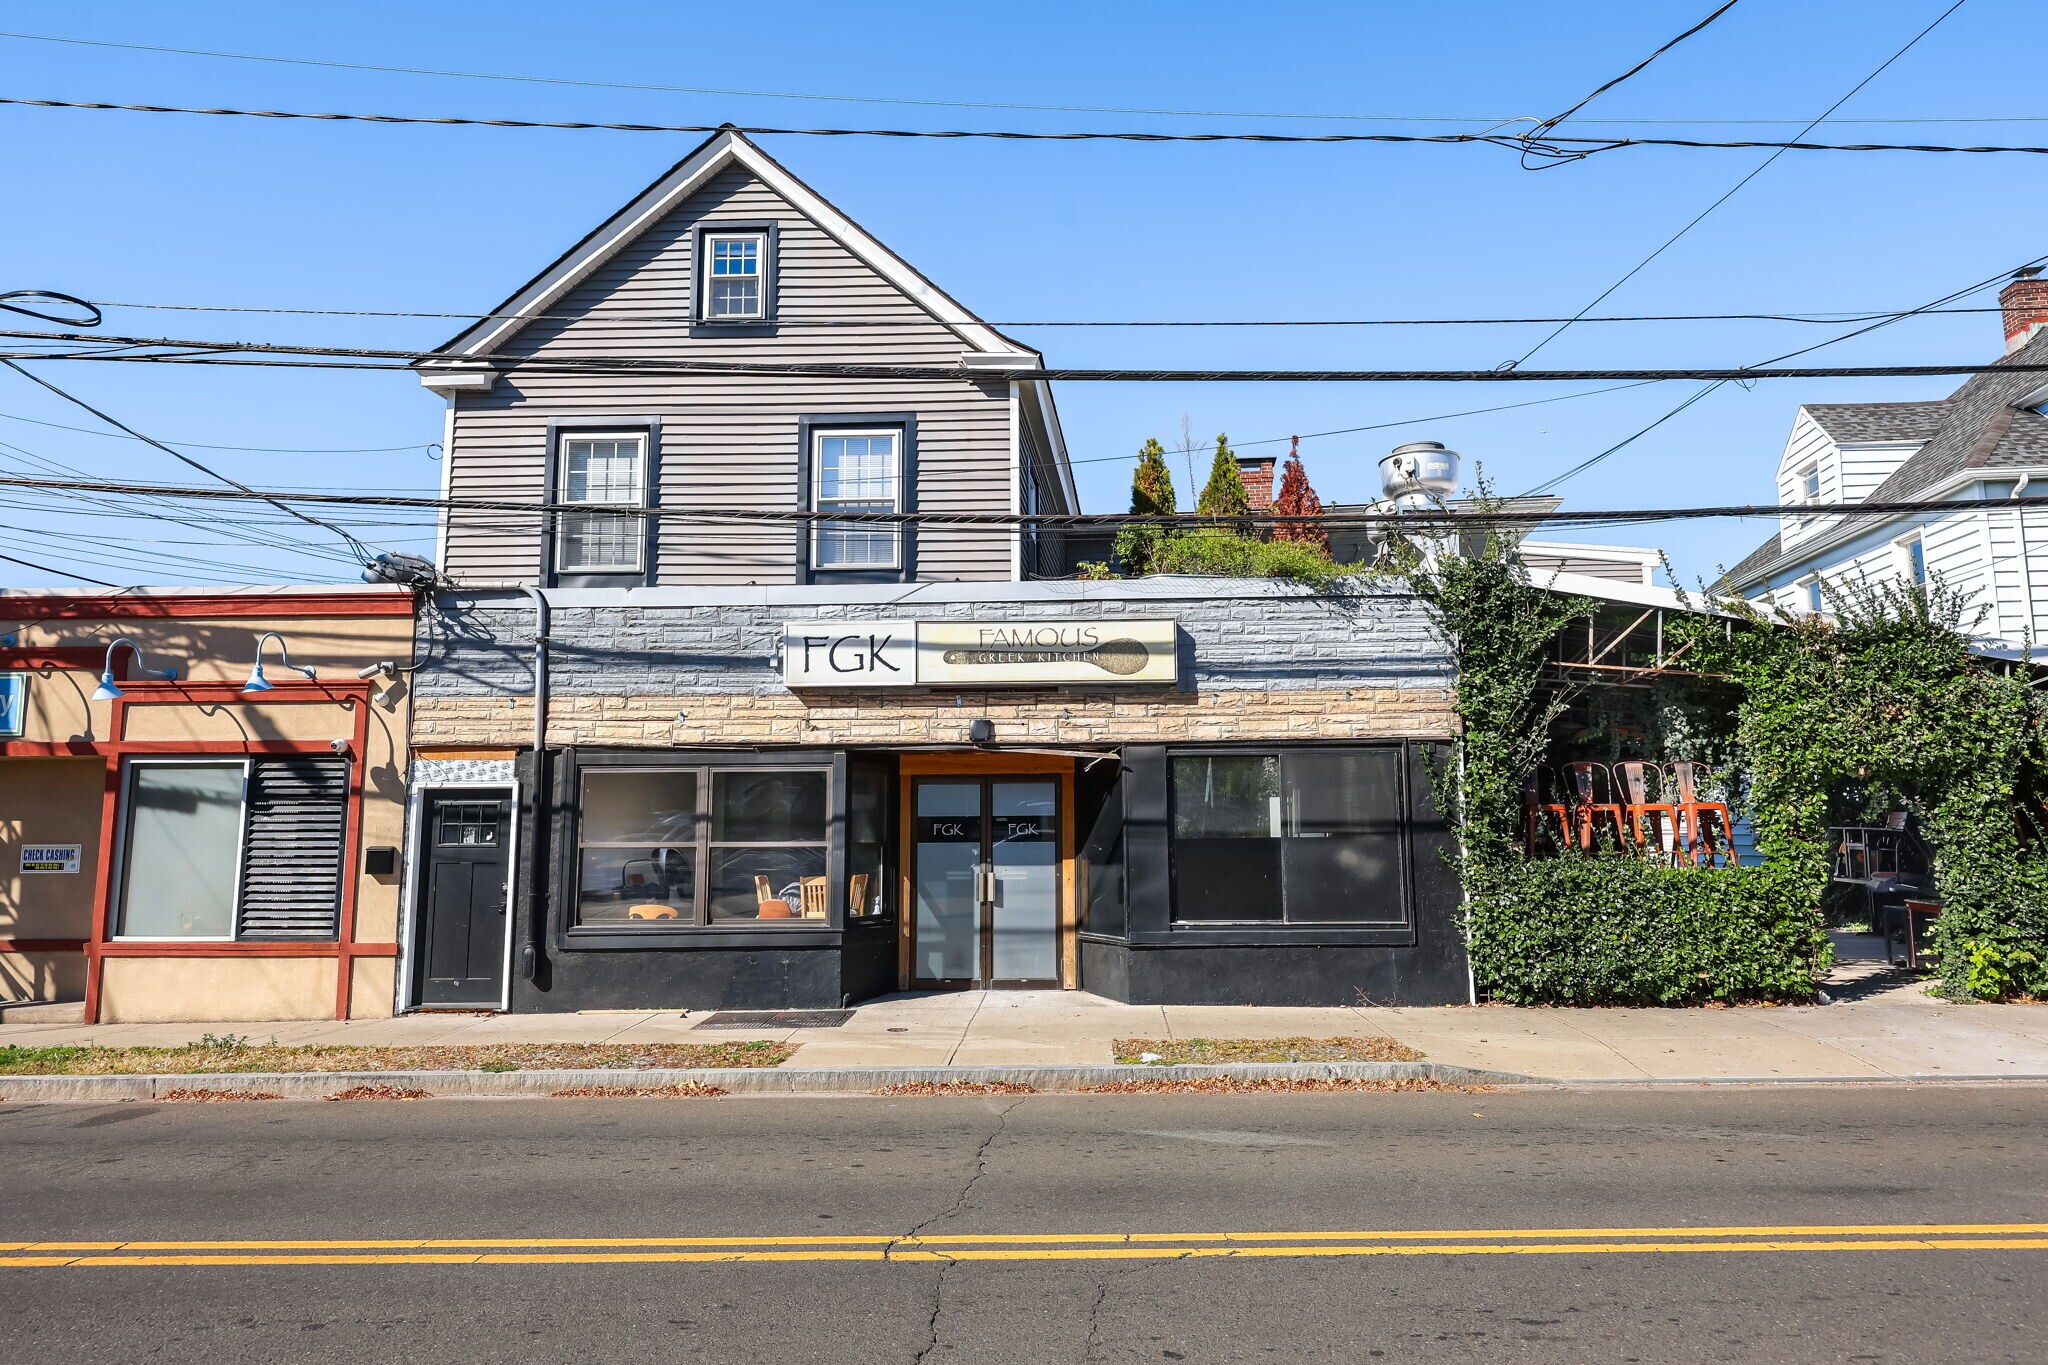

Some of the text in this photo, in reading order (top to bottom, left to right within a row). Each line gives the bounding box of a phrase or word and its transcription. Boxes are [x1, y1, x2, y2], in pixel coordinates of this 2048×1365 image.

[978, 627, 1099, 648] FAMOUS
[803, 634, 901, 673] FGK
[978, 652, 1100, 663] GREEK KITCHEN
[933, 823, 964, 836] FGK
[1008, 823, 1039, 835] FGK
[23, 849, 75, 861] CHECK CASHING
